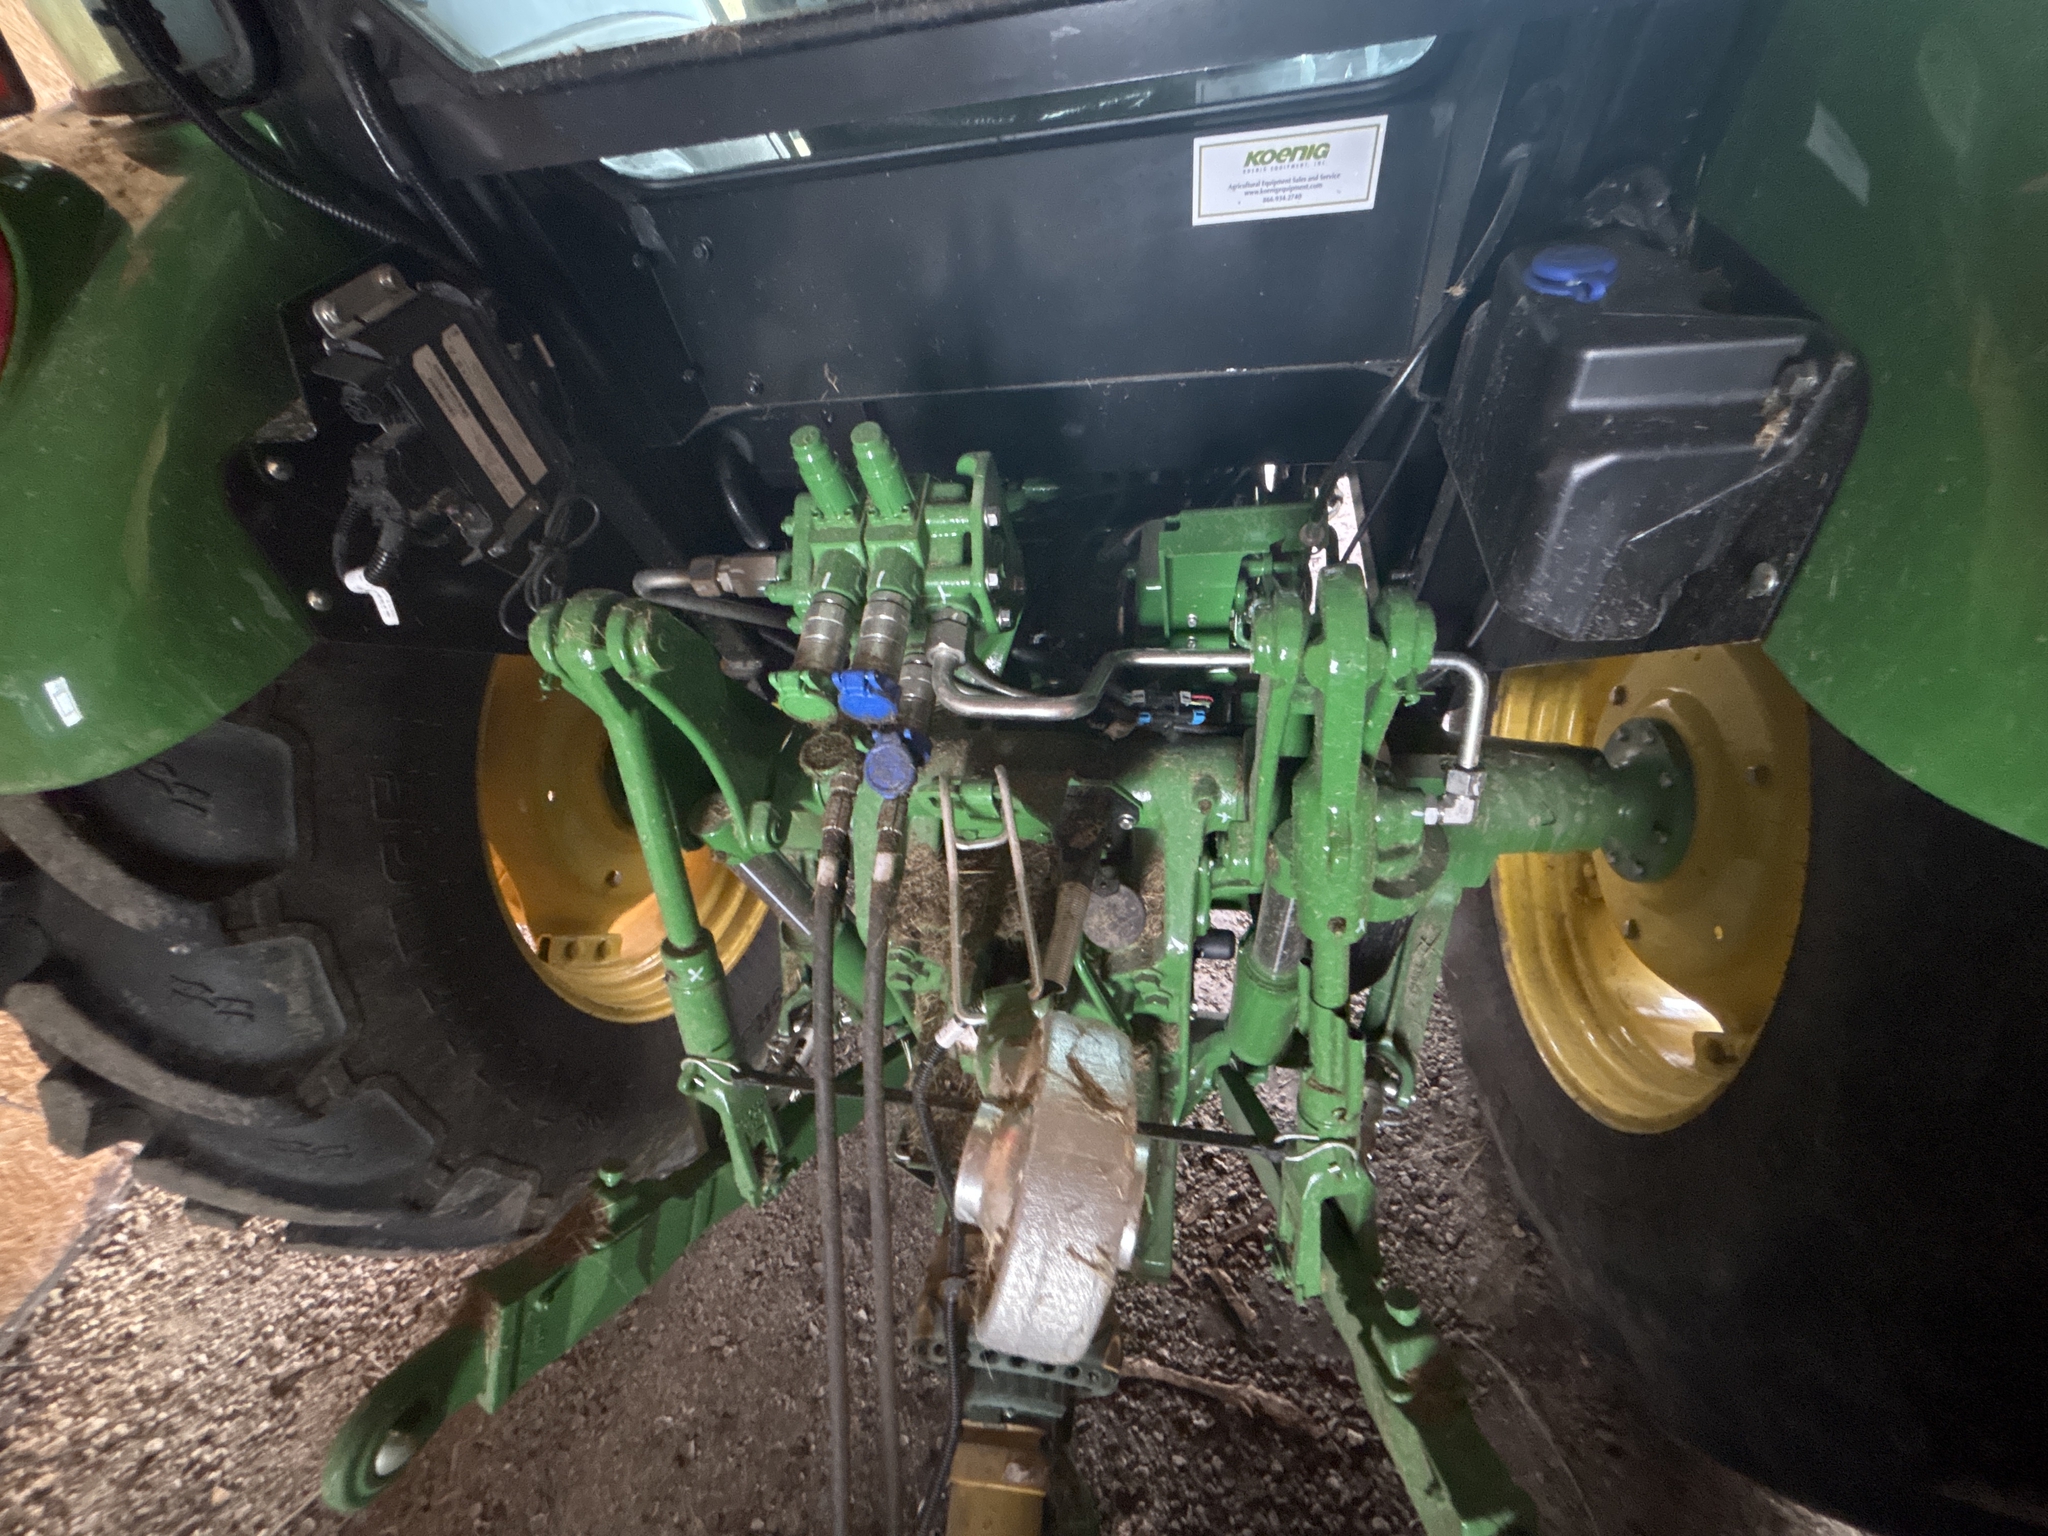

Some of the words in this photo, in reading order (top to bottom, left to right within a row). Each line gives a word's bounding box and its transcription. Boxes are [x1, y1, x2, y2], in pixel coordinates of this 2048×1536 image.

[1228, 181, 1260, 191] Agricultural
[1262, 177, 1291, 188] Equipment
[1308, 174, 1318, 182] and
